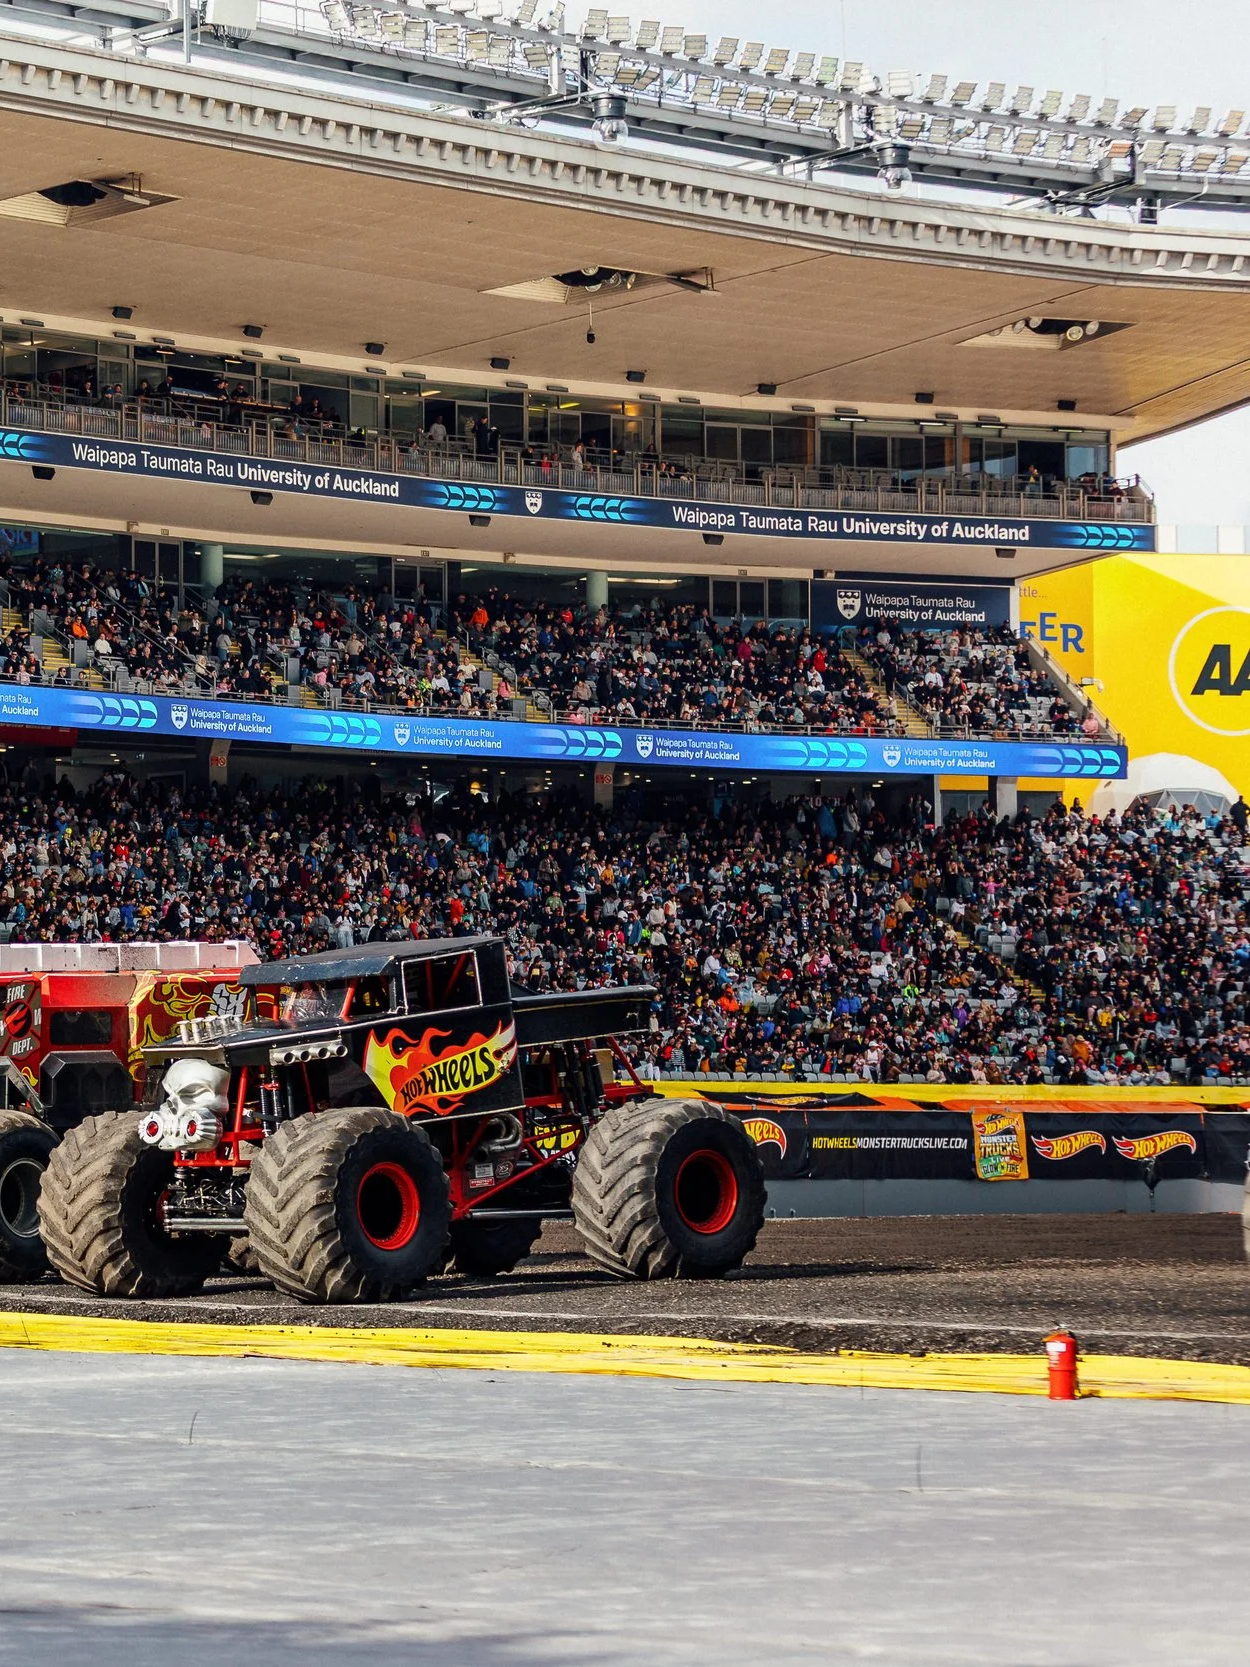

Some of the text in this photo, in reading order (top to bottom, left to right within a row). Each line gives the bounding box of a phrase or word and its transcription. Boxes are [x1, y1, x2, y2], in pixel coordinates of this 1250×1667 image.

[72, 442, 399, 498] Waipapa Taumata Rau University of Auckland
[672, 505, 1030, 541] Waipapa Taumata Rau University of Auckland
[865, 593, 975, 610] Waipapa Taumata Rau
[865, 607, 986, 622] University of Auckland
[17, 694, 32, 705] Rau
[1, 705, 39, 717] Auckland
[190, 707, 266, 723] Waipapa Taumata Rau
[190, 719, 272, 734] University of Auckland
[413, 725, 495, 738] Waipapa Taumata Rau
[413, 736, 502, 749] University of Auckland
[655, 737, 733, 750] Waipapa Taumata Rau
[655, 747, 740, 761] University of Auckland
[904, 747, 988, 758] Waipapa Taumata Rau
[904, 757, 996, 769] University of Auckland
[6, 984, 26, 1004] FIRE
[12, 1037, 33, 1056] DEPT.
[743, 1121, 780, 1143] HEELS
[812, 1136, 968, 1150] HOTWHEELSMONSTERTRUCKSLIVE.COM
[980, 1143, 1020, 1158] TRUCKS
